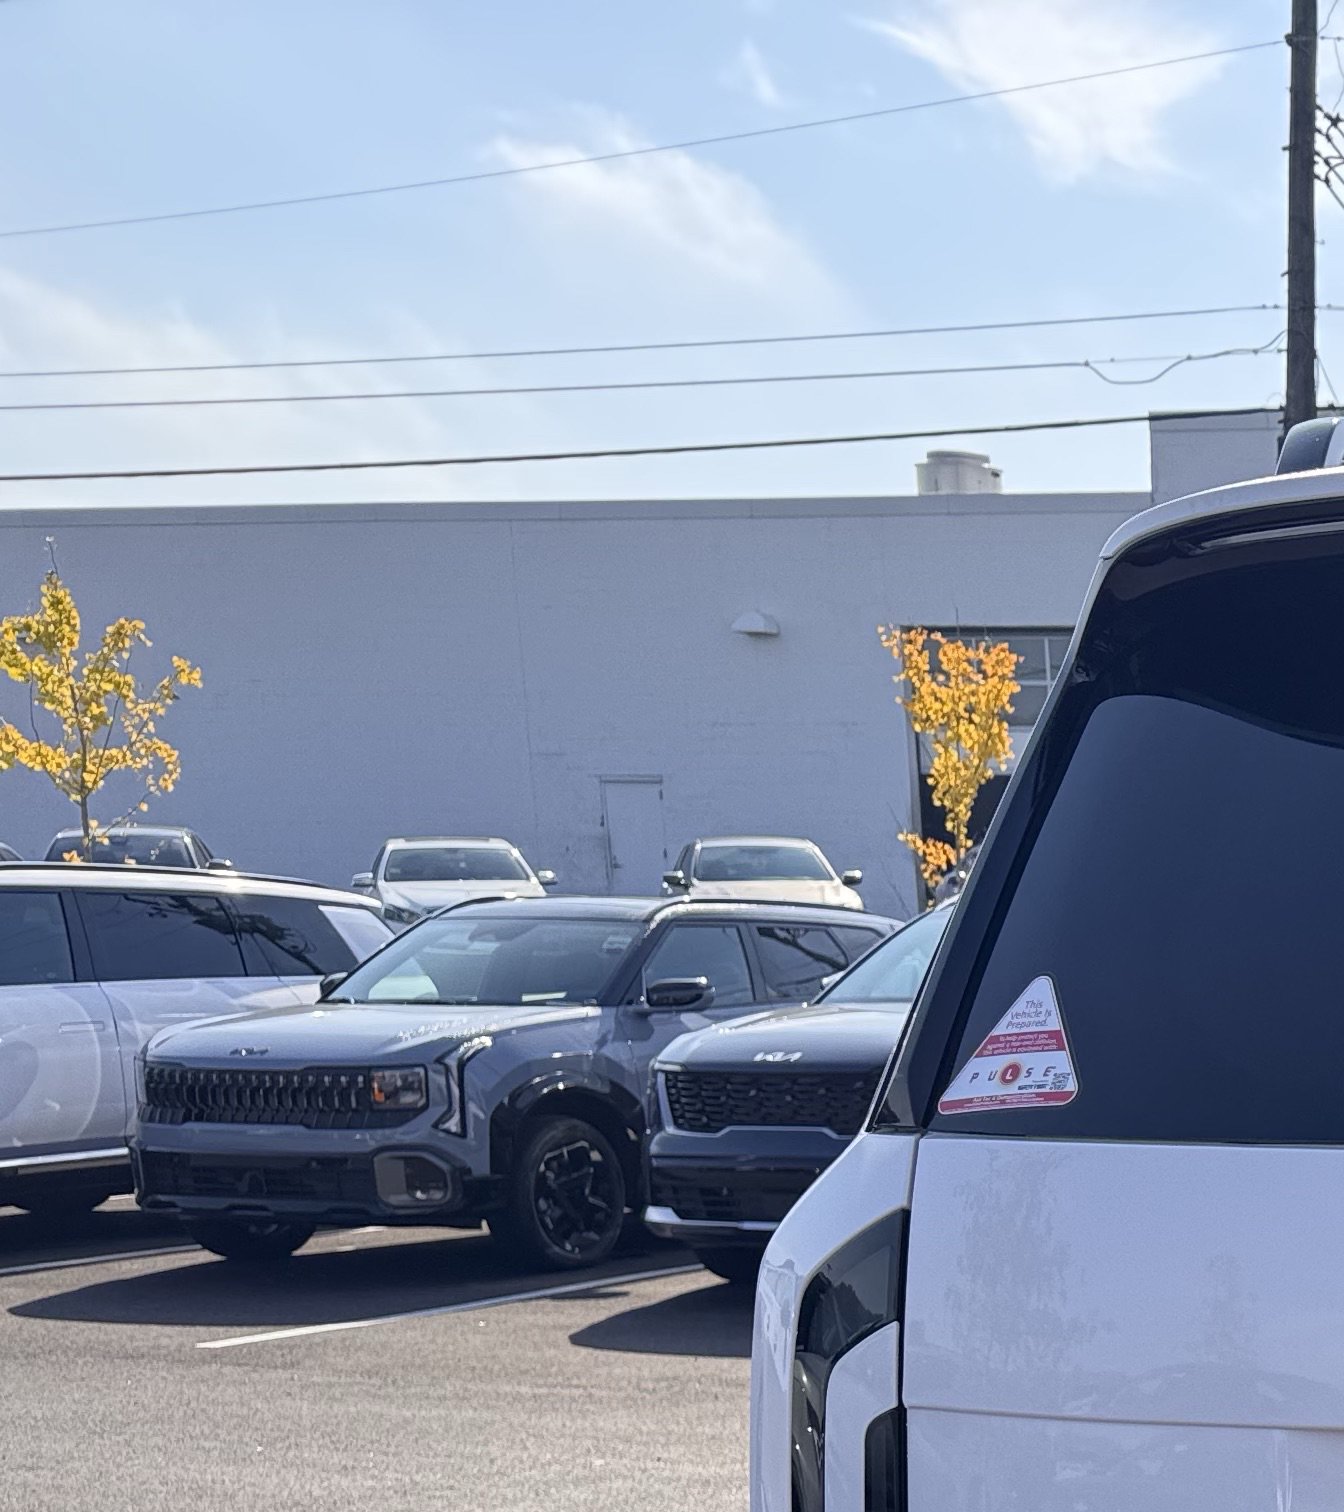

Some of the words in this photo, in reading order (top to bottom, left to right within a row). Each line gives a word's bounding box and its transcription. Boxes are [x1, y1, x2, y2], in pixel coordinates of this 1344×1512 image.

[1025, 1000, 1044, 1009] This
[1010, 1009, 1042, 1021] Vehicle
[969, 1065, 1056, 1084] PULSE
